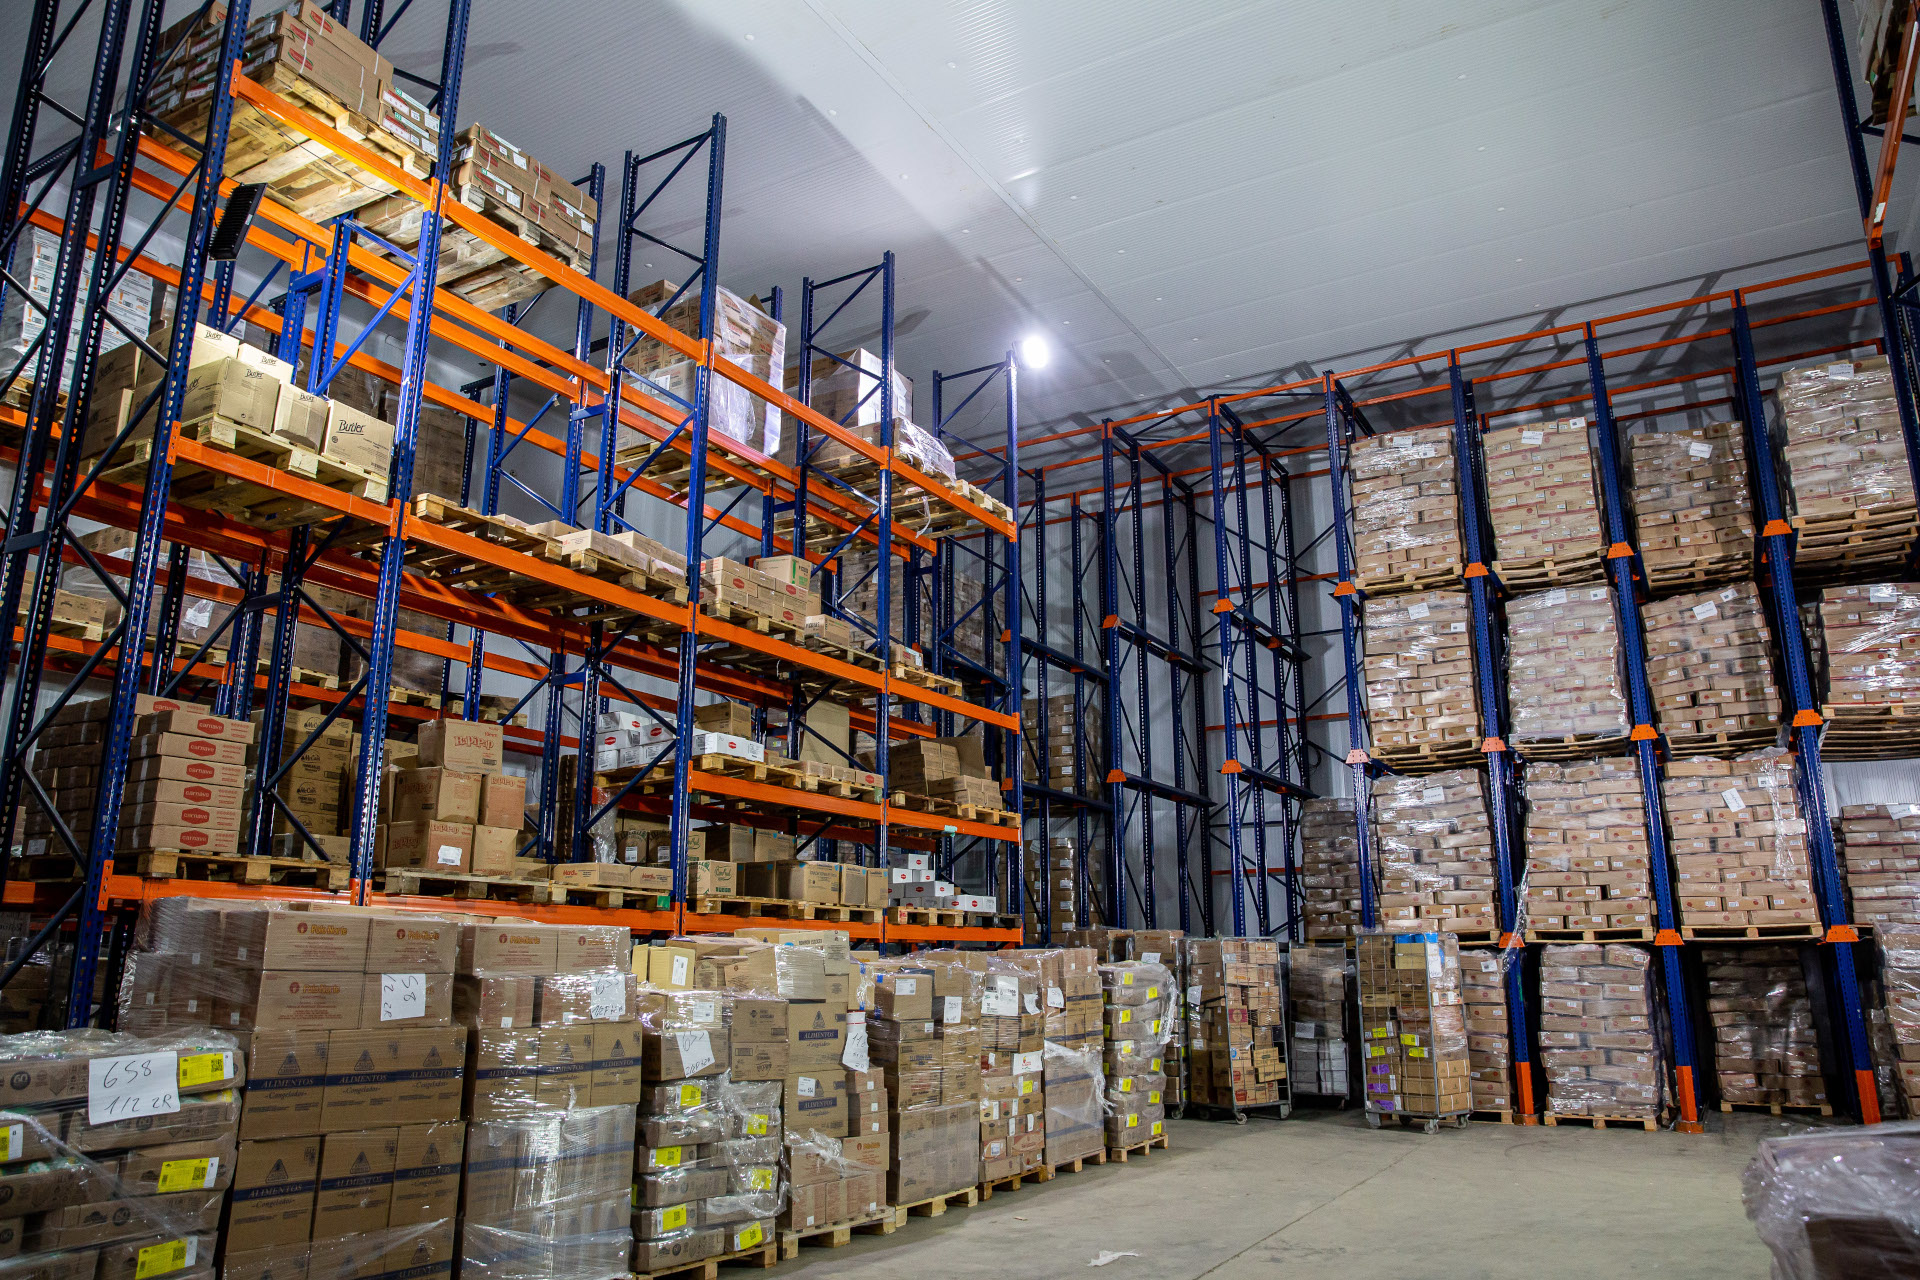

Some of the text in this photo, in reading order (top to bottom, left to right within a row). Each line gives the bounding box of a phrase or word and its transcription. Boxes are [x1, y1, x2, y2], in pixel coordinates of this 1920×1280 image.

[338, 419, 365, 434] Butler
[804, 1030, 835, 1040] ALIMENTOS
[602, 1059, 634, 1069] ALIMENTOS
[103, 1060, 152, 1089] 658
[339, 1073, 388, 1085] ALIMENTOS
[409, 1069, 455, 1080] ALIMENTOS
[262, 1077, 315, 1089] ALIMENTOS
[335, 1174, 384, 1188] ALIMENTOS
[248, 1184, 303, 1198] ALIMENTOS
